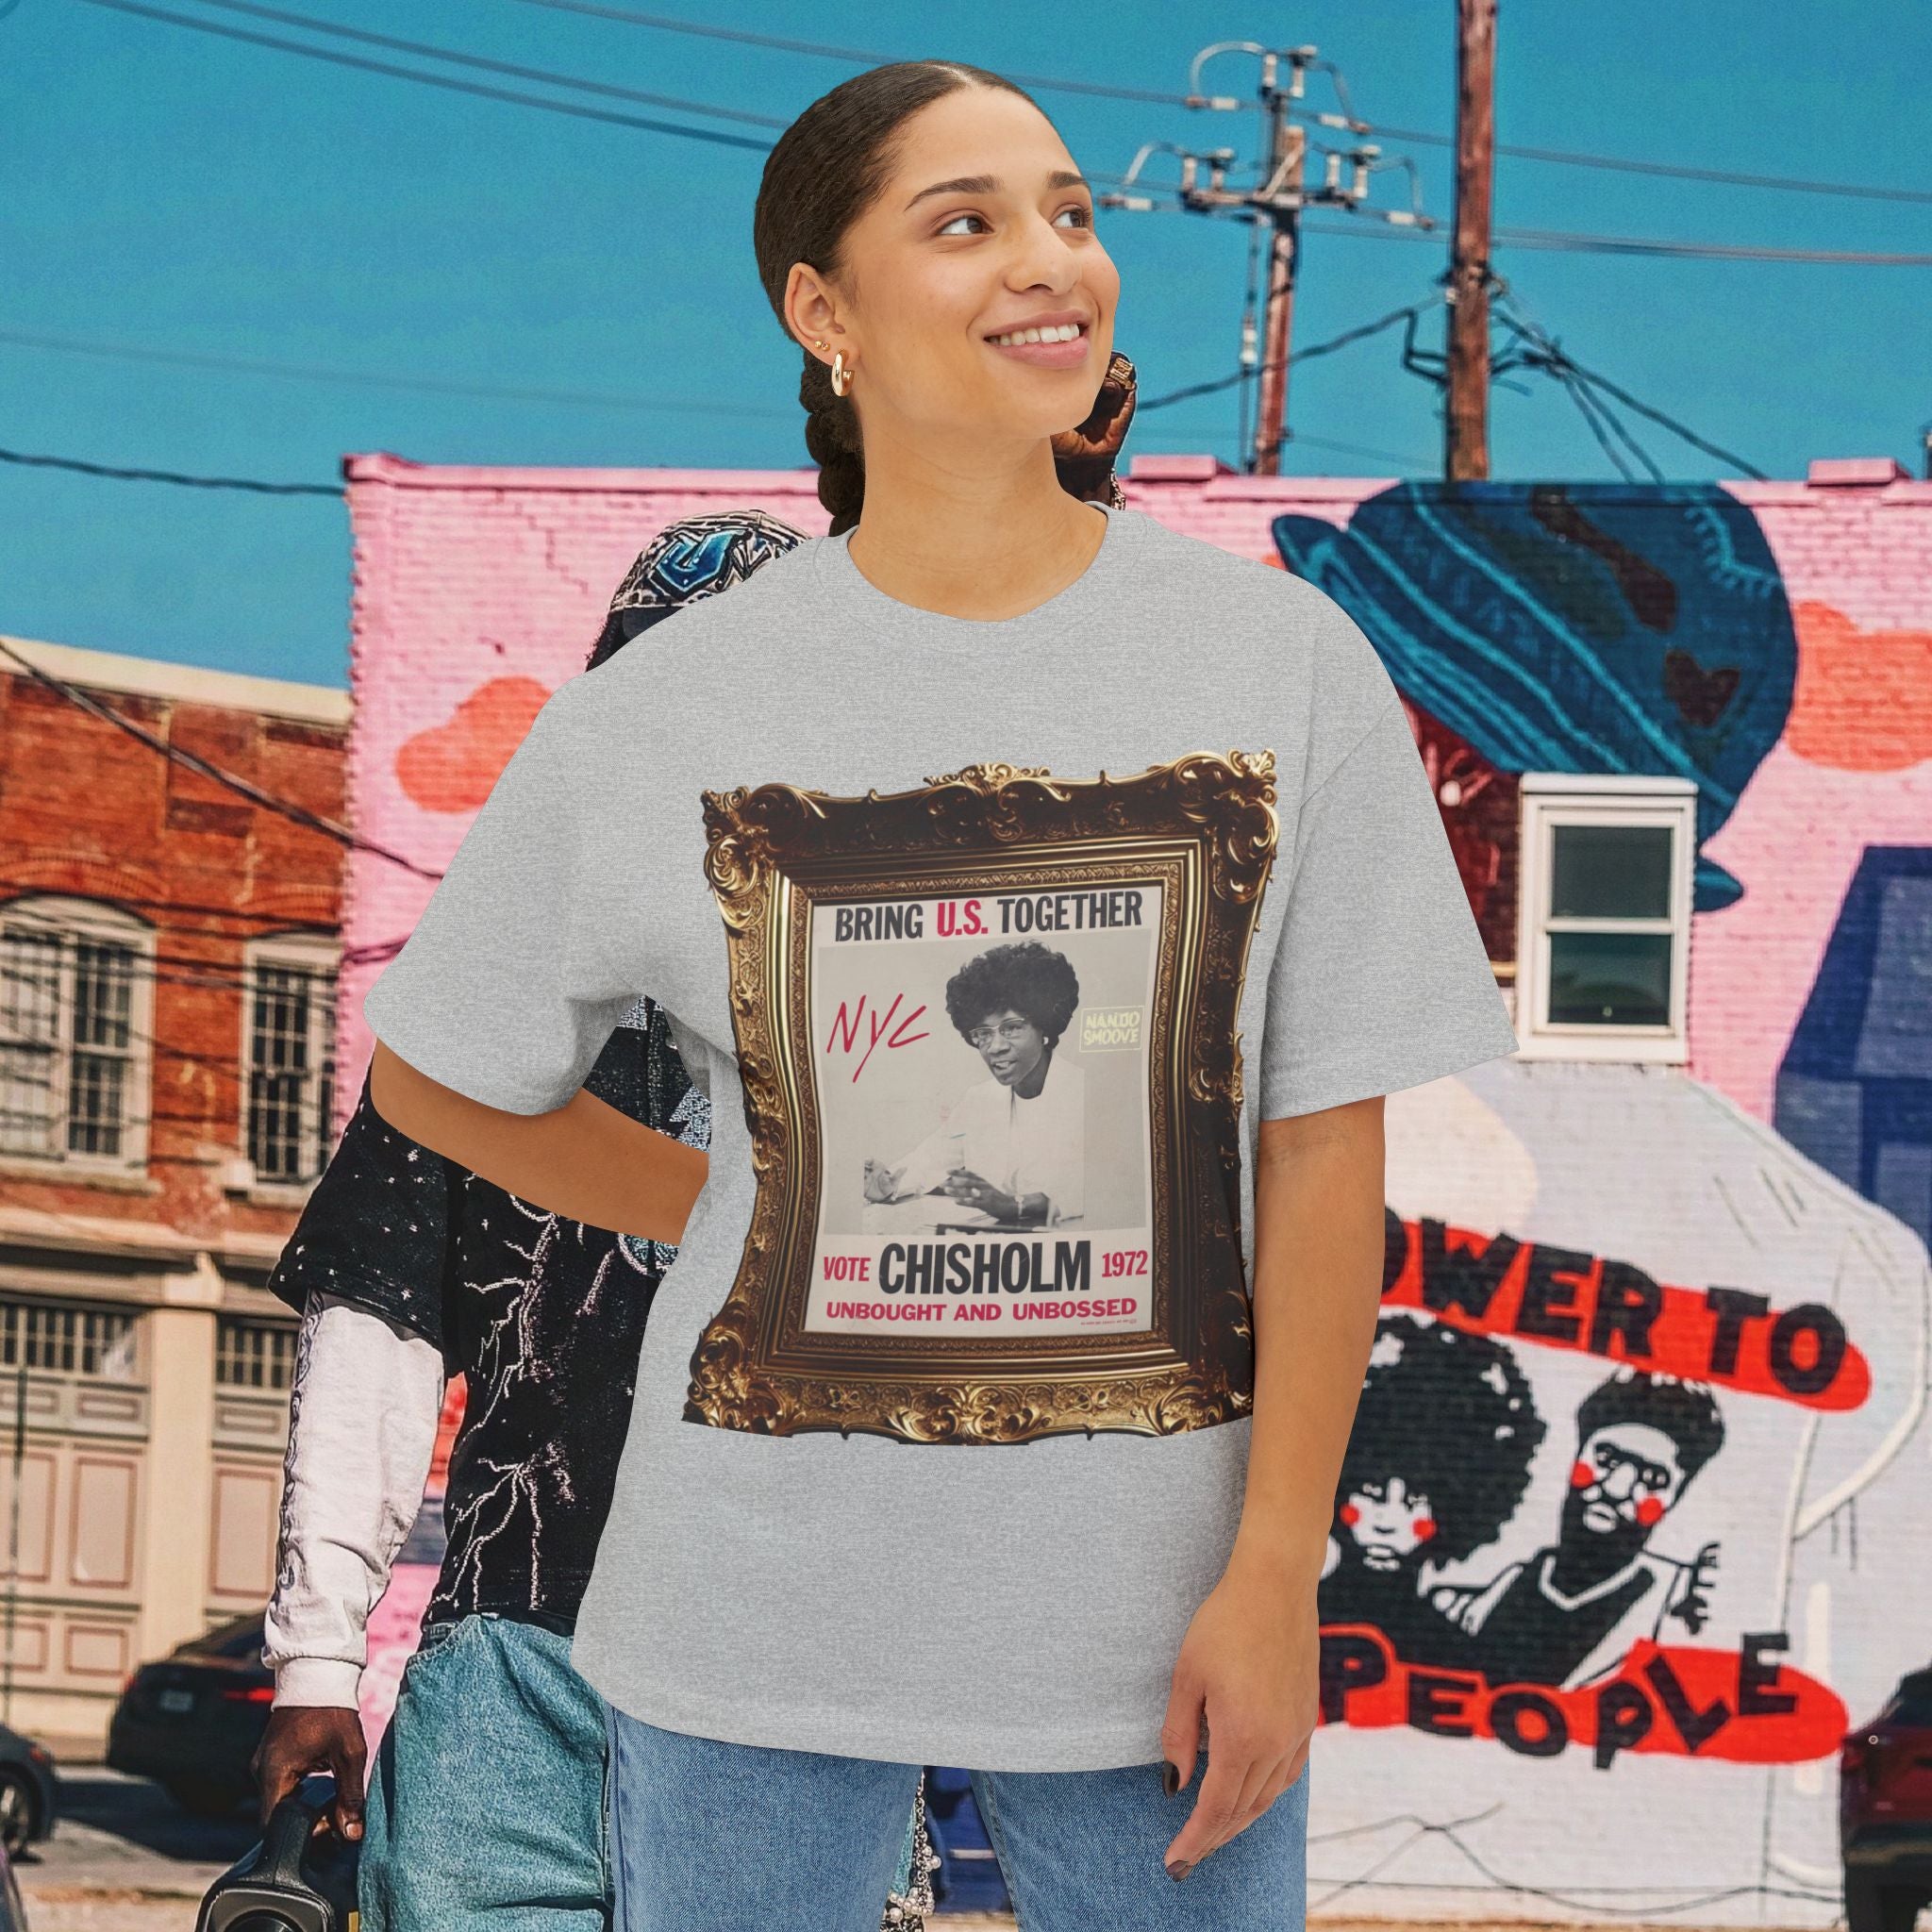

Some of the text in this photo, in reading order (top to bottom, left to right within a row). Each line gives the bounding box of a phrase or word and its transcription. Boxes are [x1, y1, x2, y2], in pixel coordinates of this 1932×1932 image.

[835, 891, 1142, 942] BRING U.S. TOGETHER
[826, 992, 930, 1083] NYC
[1083, 1027, 1139, 1046] SMOOVE
[824, 1240, 1148, 1295] VOTE CHISHOLM 1972
[825, 1297, 1138, 1322] UNBOUGHT AND UNBOSSED
[1707, 1285, 1847, 1395] TO
[1319, 1632, 1799, 1770] PEOPLE
